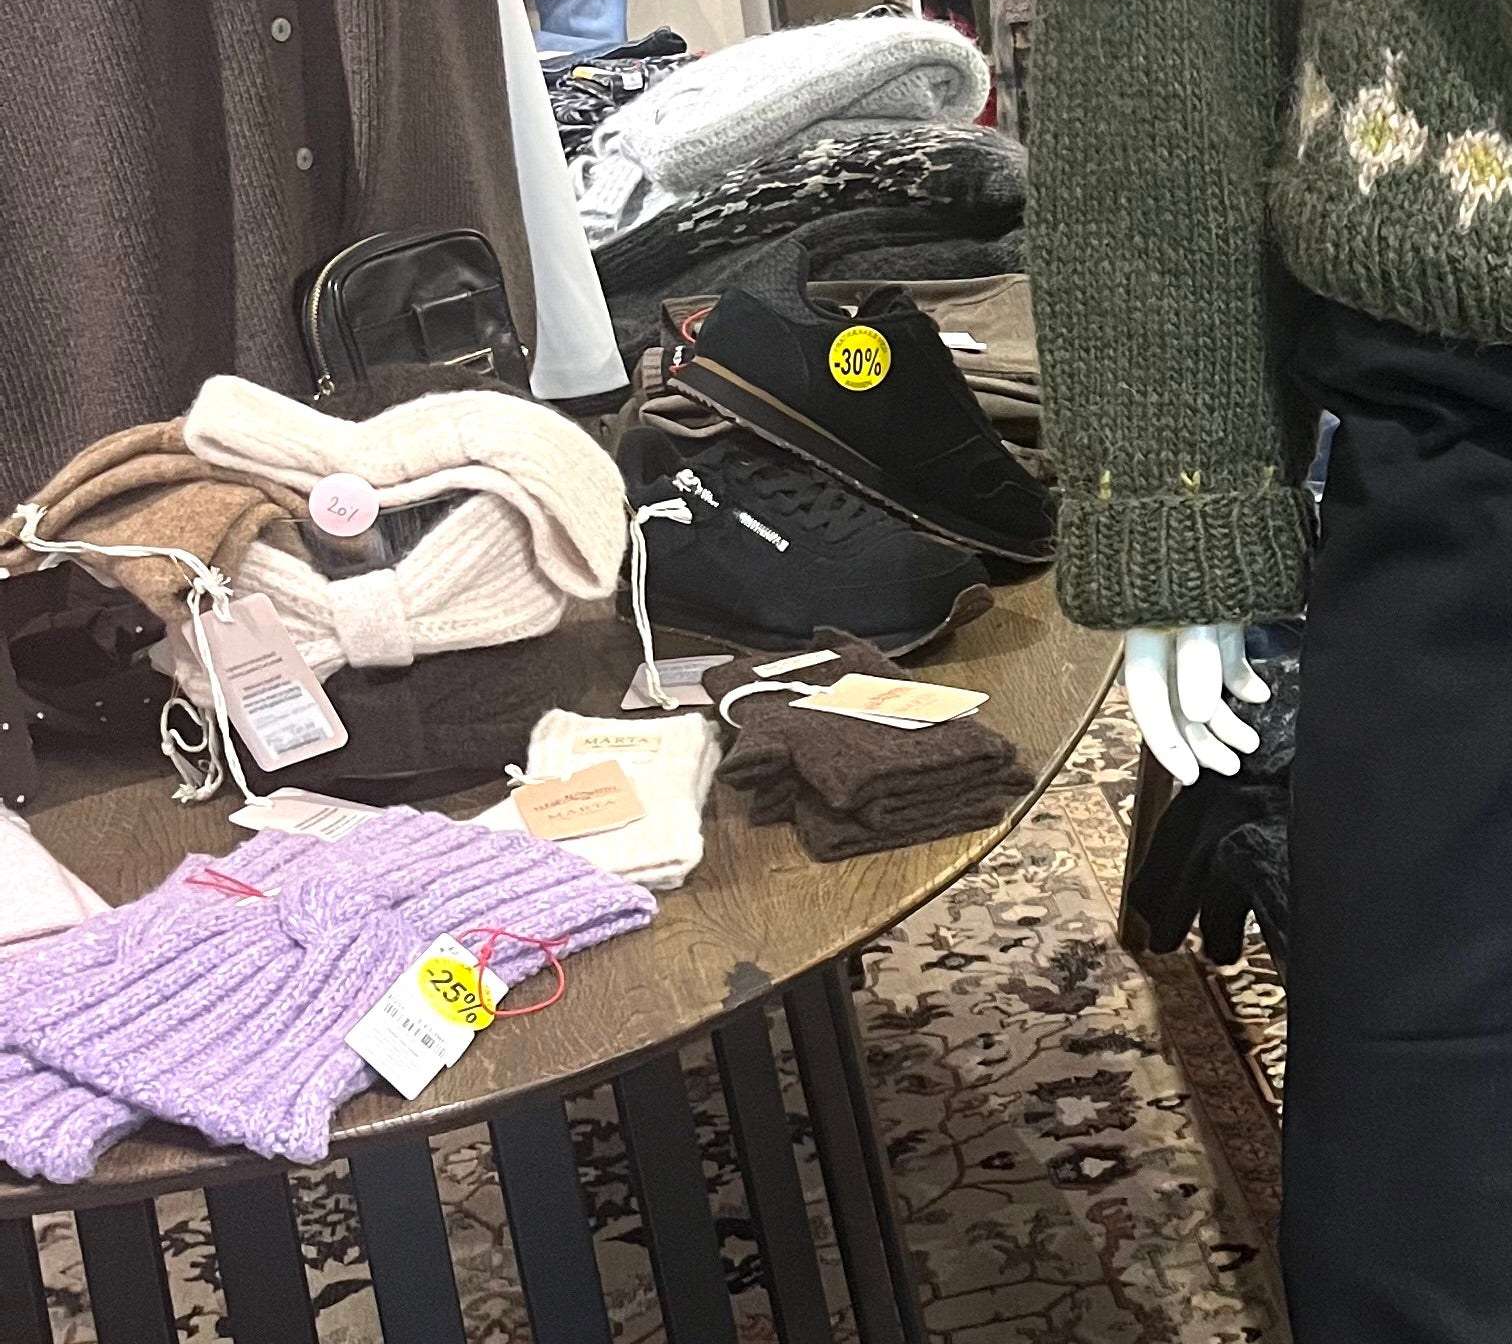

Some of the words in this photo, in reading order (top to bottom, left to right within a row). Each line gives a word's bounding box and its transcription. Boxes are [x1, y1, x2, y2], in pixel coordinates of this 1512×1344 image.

[834, 348, 882, 377] -30%
[584, 736, 649, 745] MARTA
[426, 969, 482, 1024] -25%
